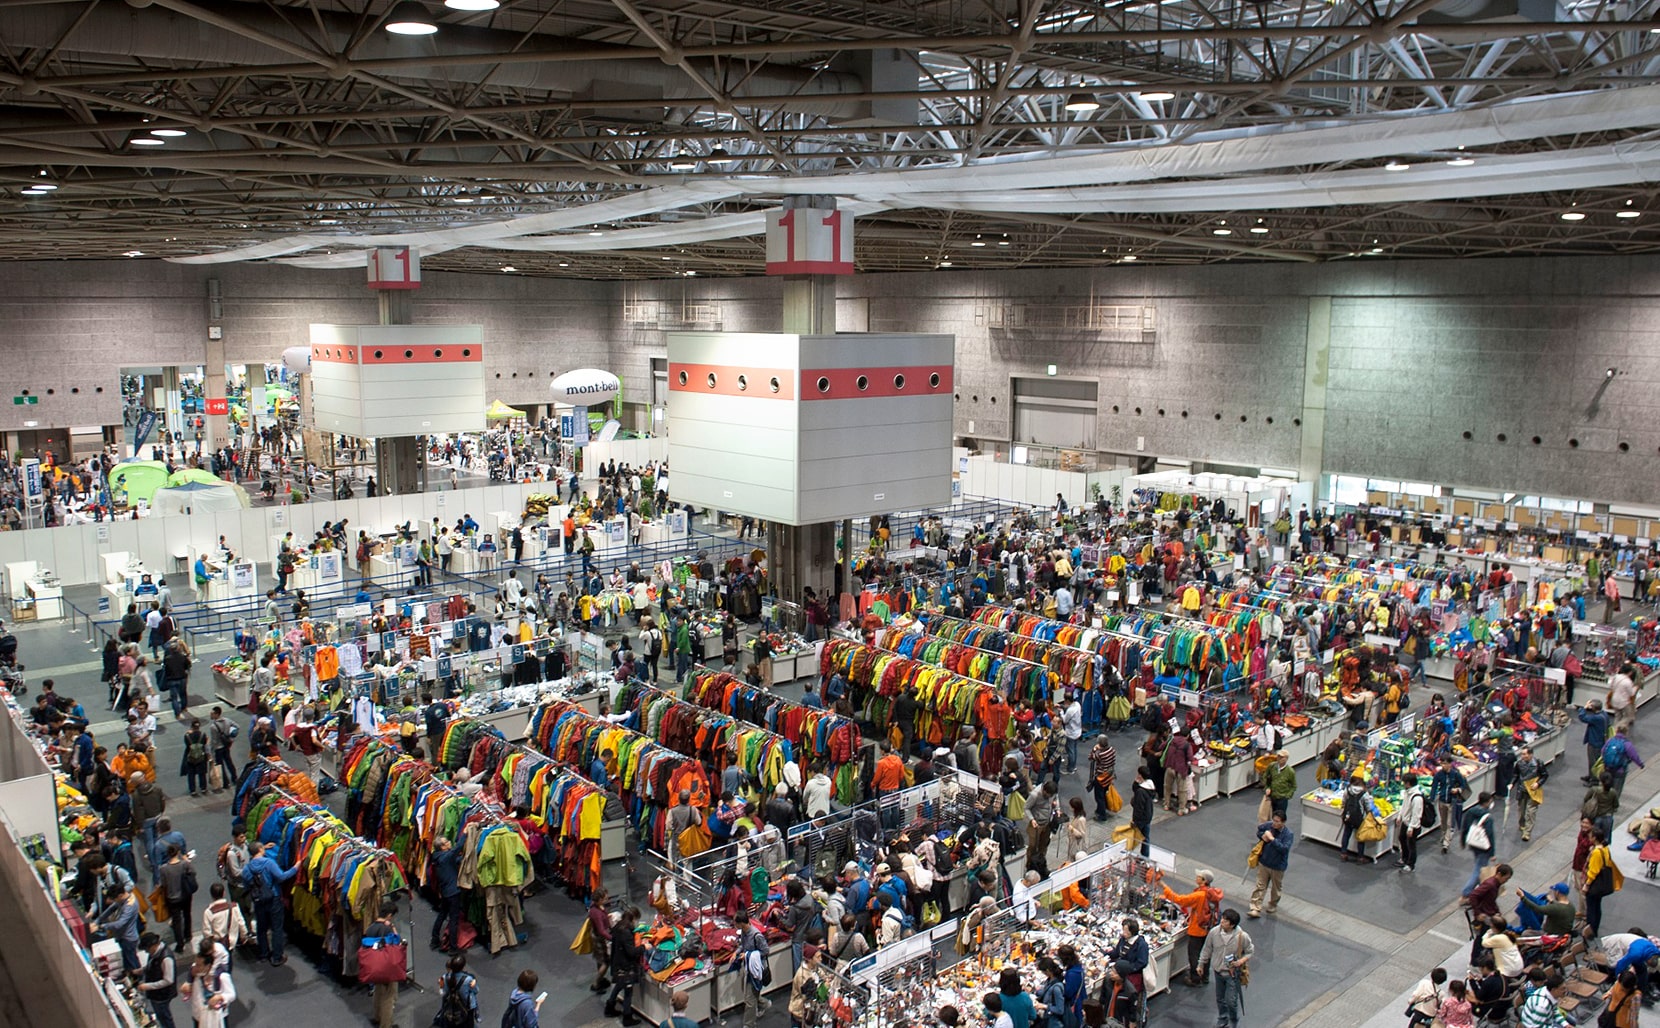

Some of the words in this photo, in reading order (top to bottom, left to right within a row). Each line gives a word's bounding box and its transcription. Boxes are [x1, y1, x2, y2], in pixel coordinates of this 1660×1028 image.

[779, 208, 795, 262] 1
[822, 208, 841, 262] 1
[395, 245, 410, 282] 1
[514, 647, 522, 656] S
[389, 681, 397, 690] L
